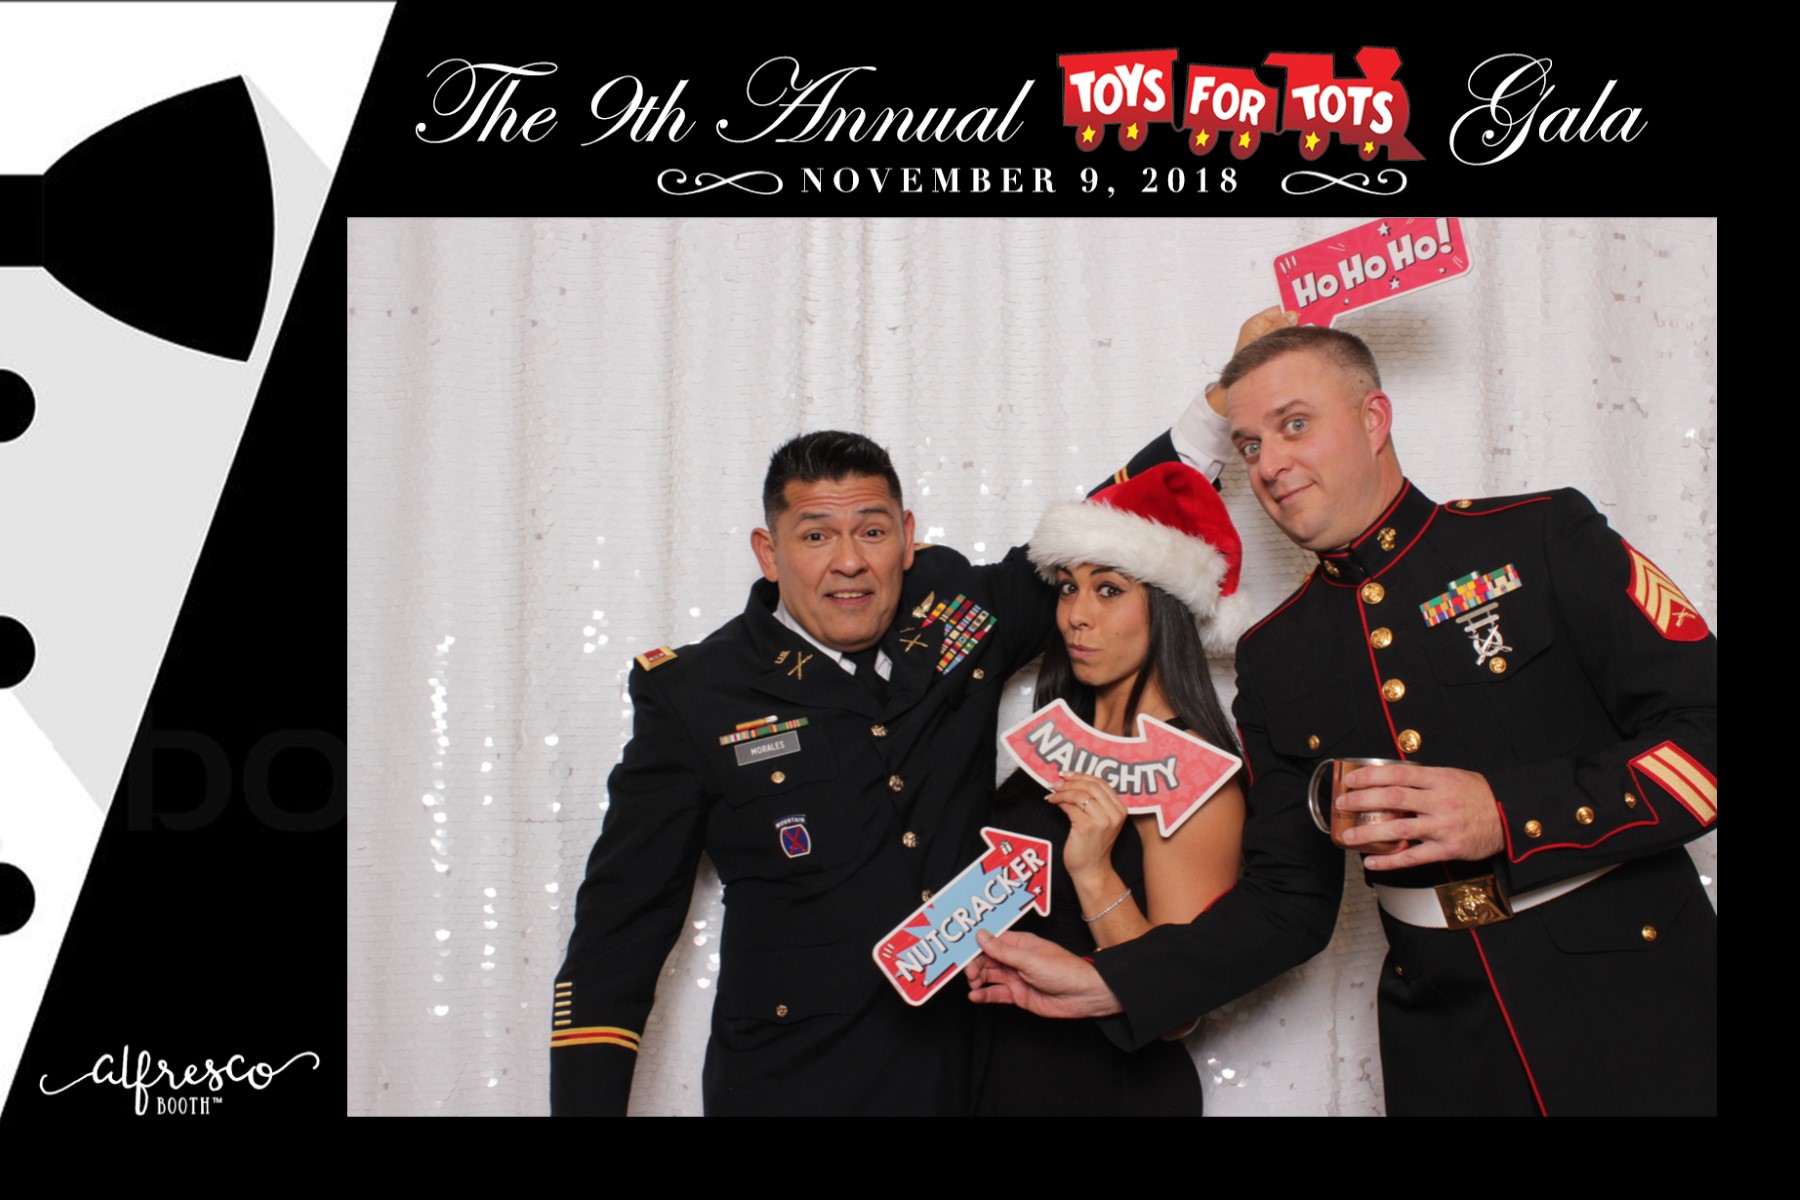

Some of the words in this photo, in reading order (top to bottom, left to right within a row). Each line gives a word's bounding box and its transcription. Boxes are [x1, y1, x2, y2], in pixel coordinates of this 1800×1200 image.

[750, 740, 786, 756] MORALES
[1027, 719, 1179, 795] NAUGHTY
[894, 847, 1046, 983] NUTCRACKER
